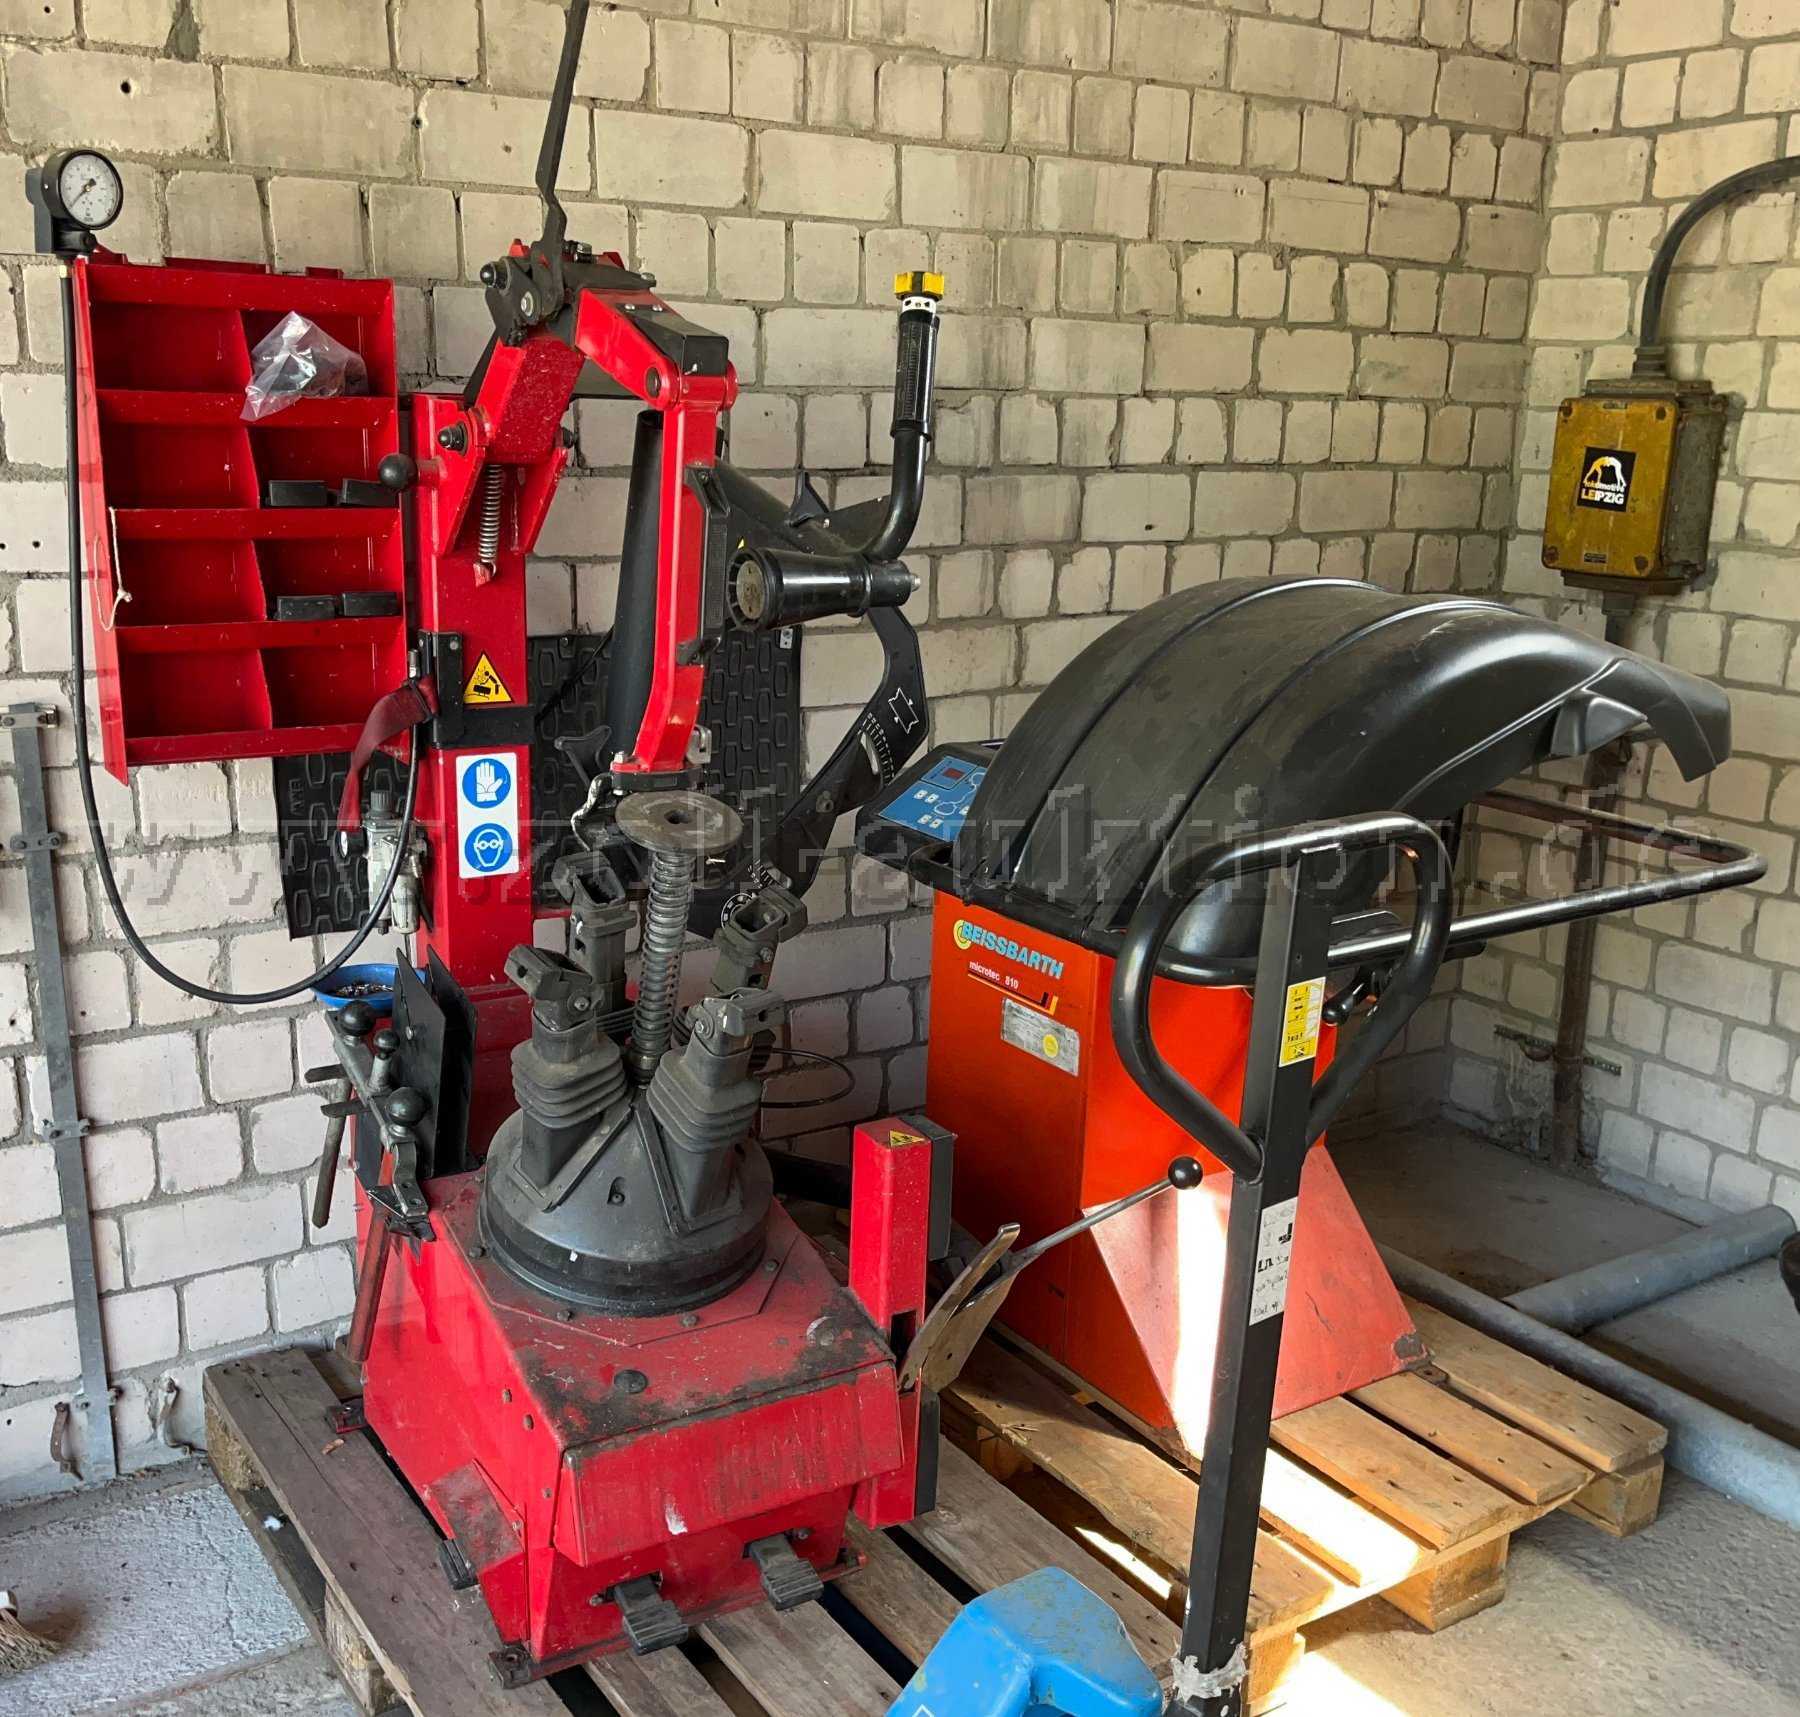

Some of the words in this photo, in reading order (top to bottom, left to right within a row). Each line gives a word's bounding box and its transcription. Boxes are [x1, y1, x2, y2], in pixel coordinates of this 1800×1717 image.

[1581, 488, 1624, 504] LEIPZIG
[961, 921, 1064, 979] BEISSBARTH
[969, 961, 1000, 981] microtec
